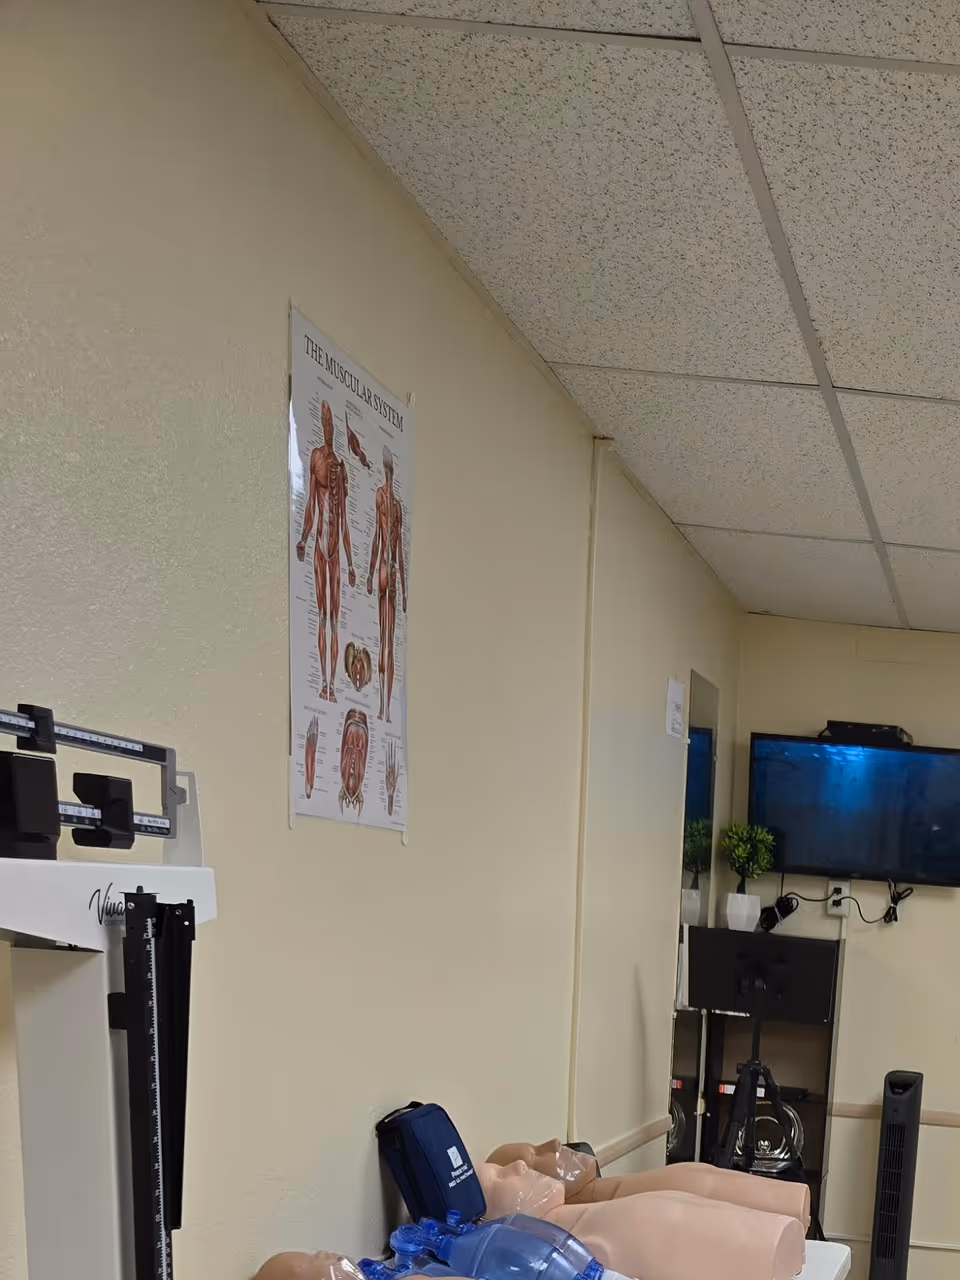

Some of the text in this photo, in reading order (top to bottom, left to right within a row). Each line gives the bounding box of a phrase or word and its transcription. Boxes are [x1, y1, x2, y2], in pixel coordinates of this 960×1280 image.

[304, 334, 324, 367] THE
[325, 352, 373, 408] MUSCULAR
[373, 393, 404, 433] SYSTEM
